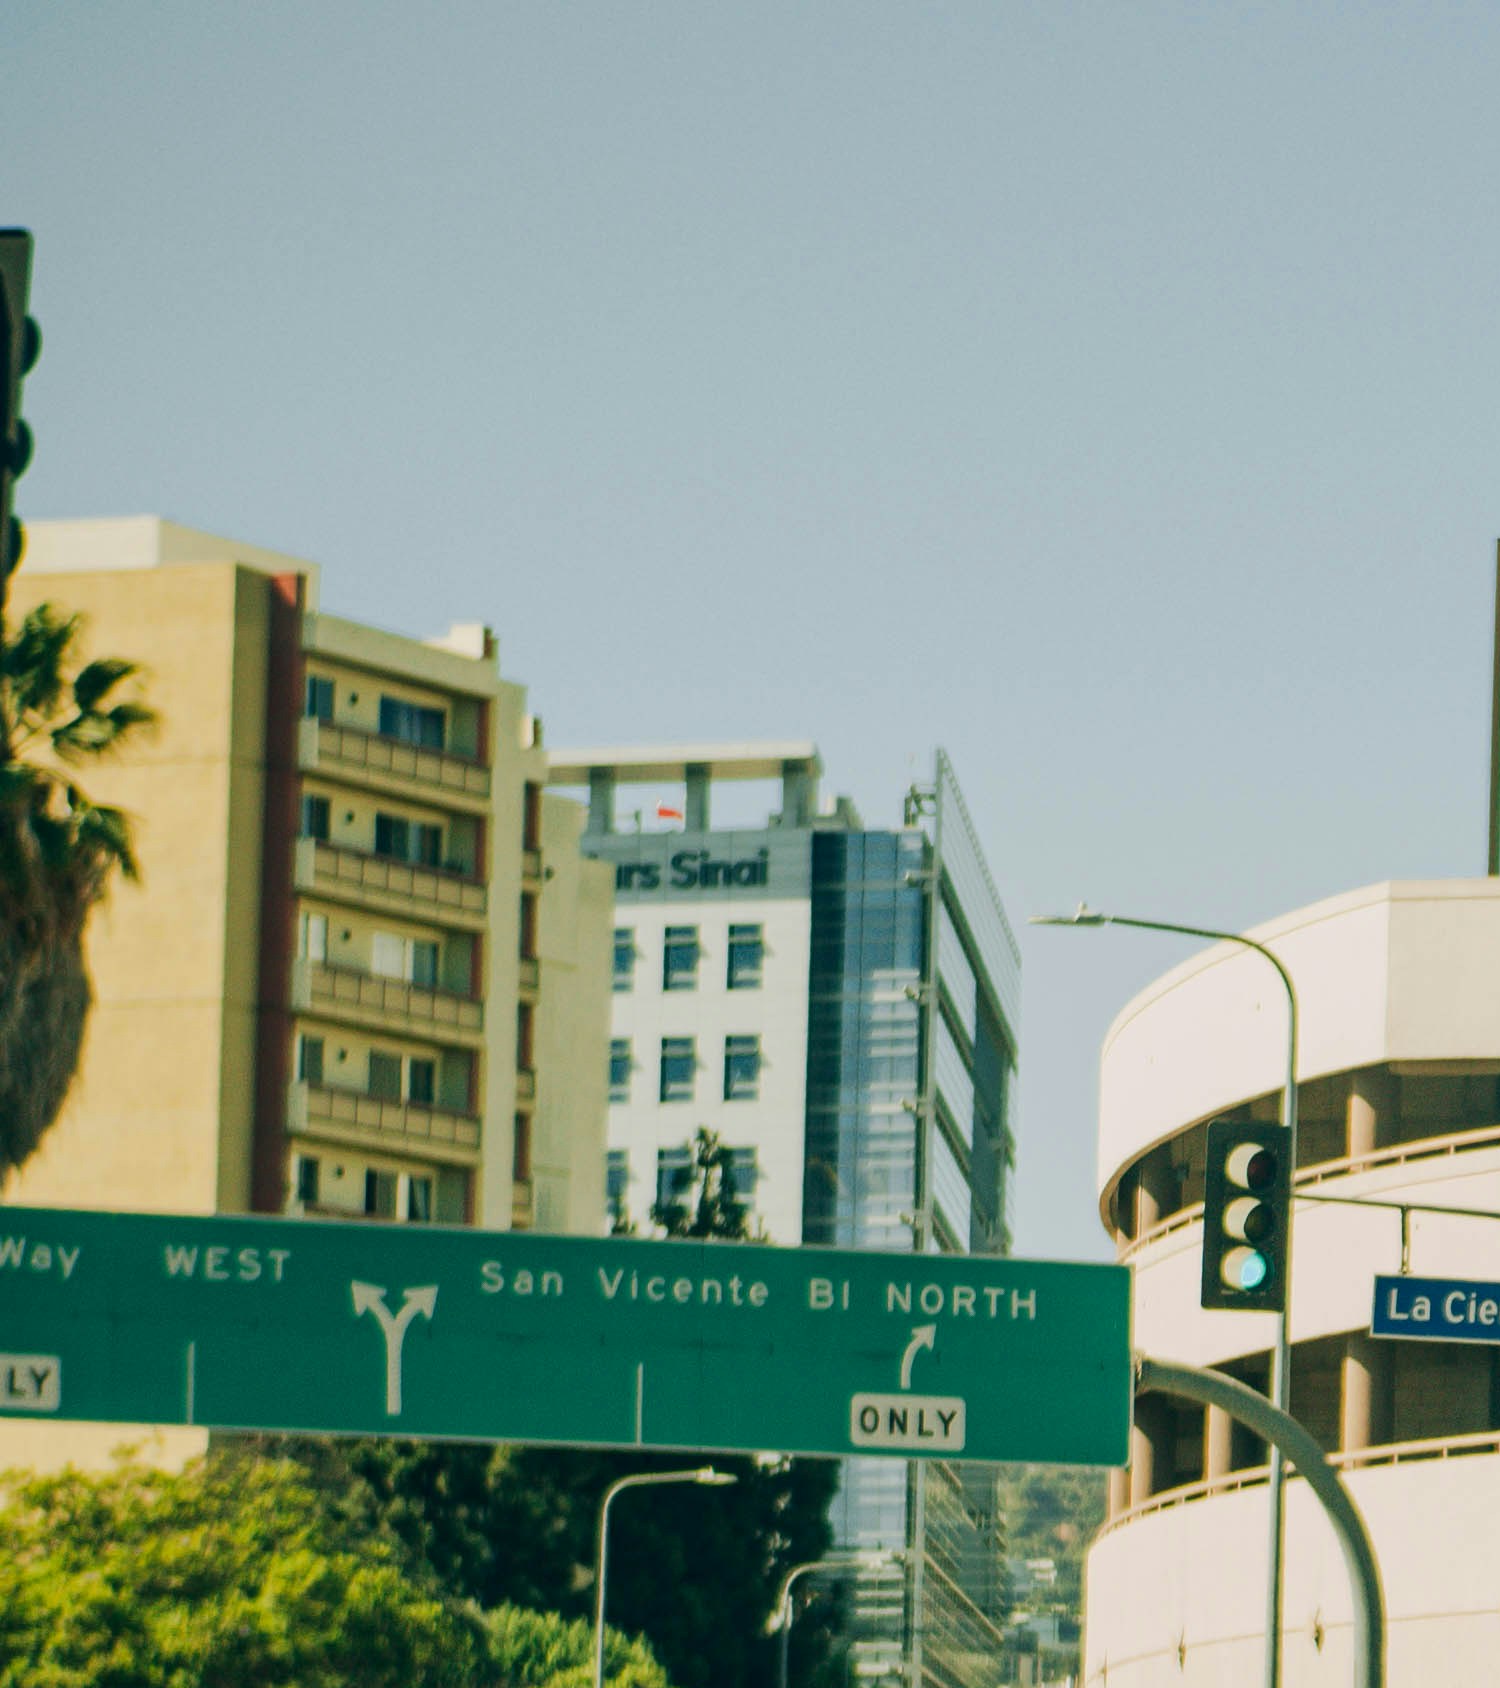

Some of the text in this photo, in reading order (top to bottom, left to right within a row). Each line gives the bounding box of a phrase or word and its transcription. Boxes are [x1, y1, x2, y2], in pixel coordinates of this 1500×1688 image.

[669, 847, 770, 889] Sinai
[163, 1244, 291, 1282] WEST
[480, 1260, 1038, 1321] San Vicente Bl NORTH
[1388, 1287, 1431, 1322] La
[8, 1364, 50, 1398] LY
[859, 1404, 958, 1438] ONLY
